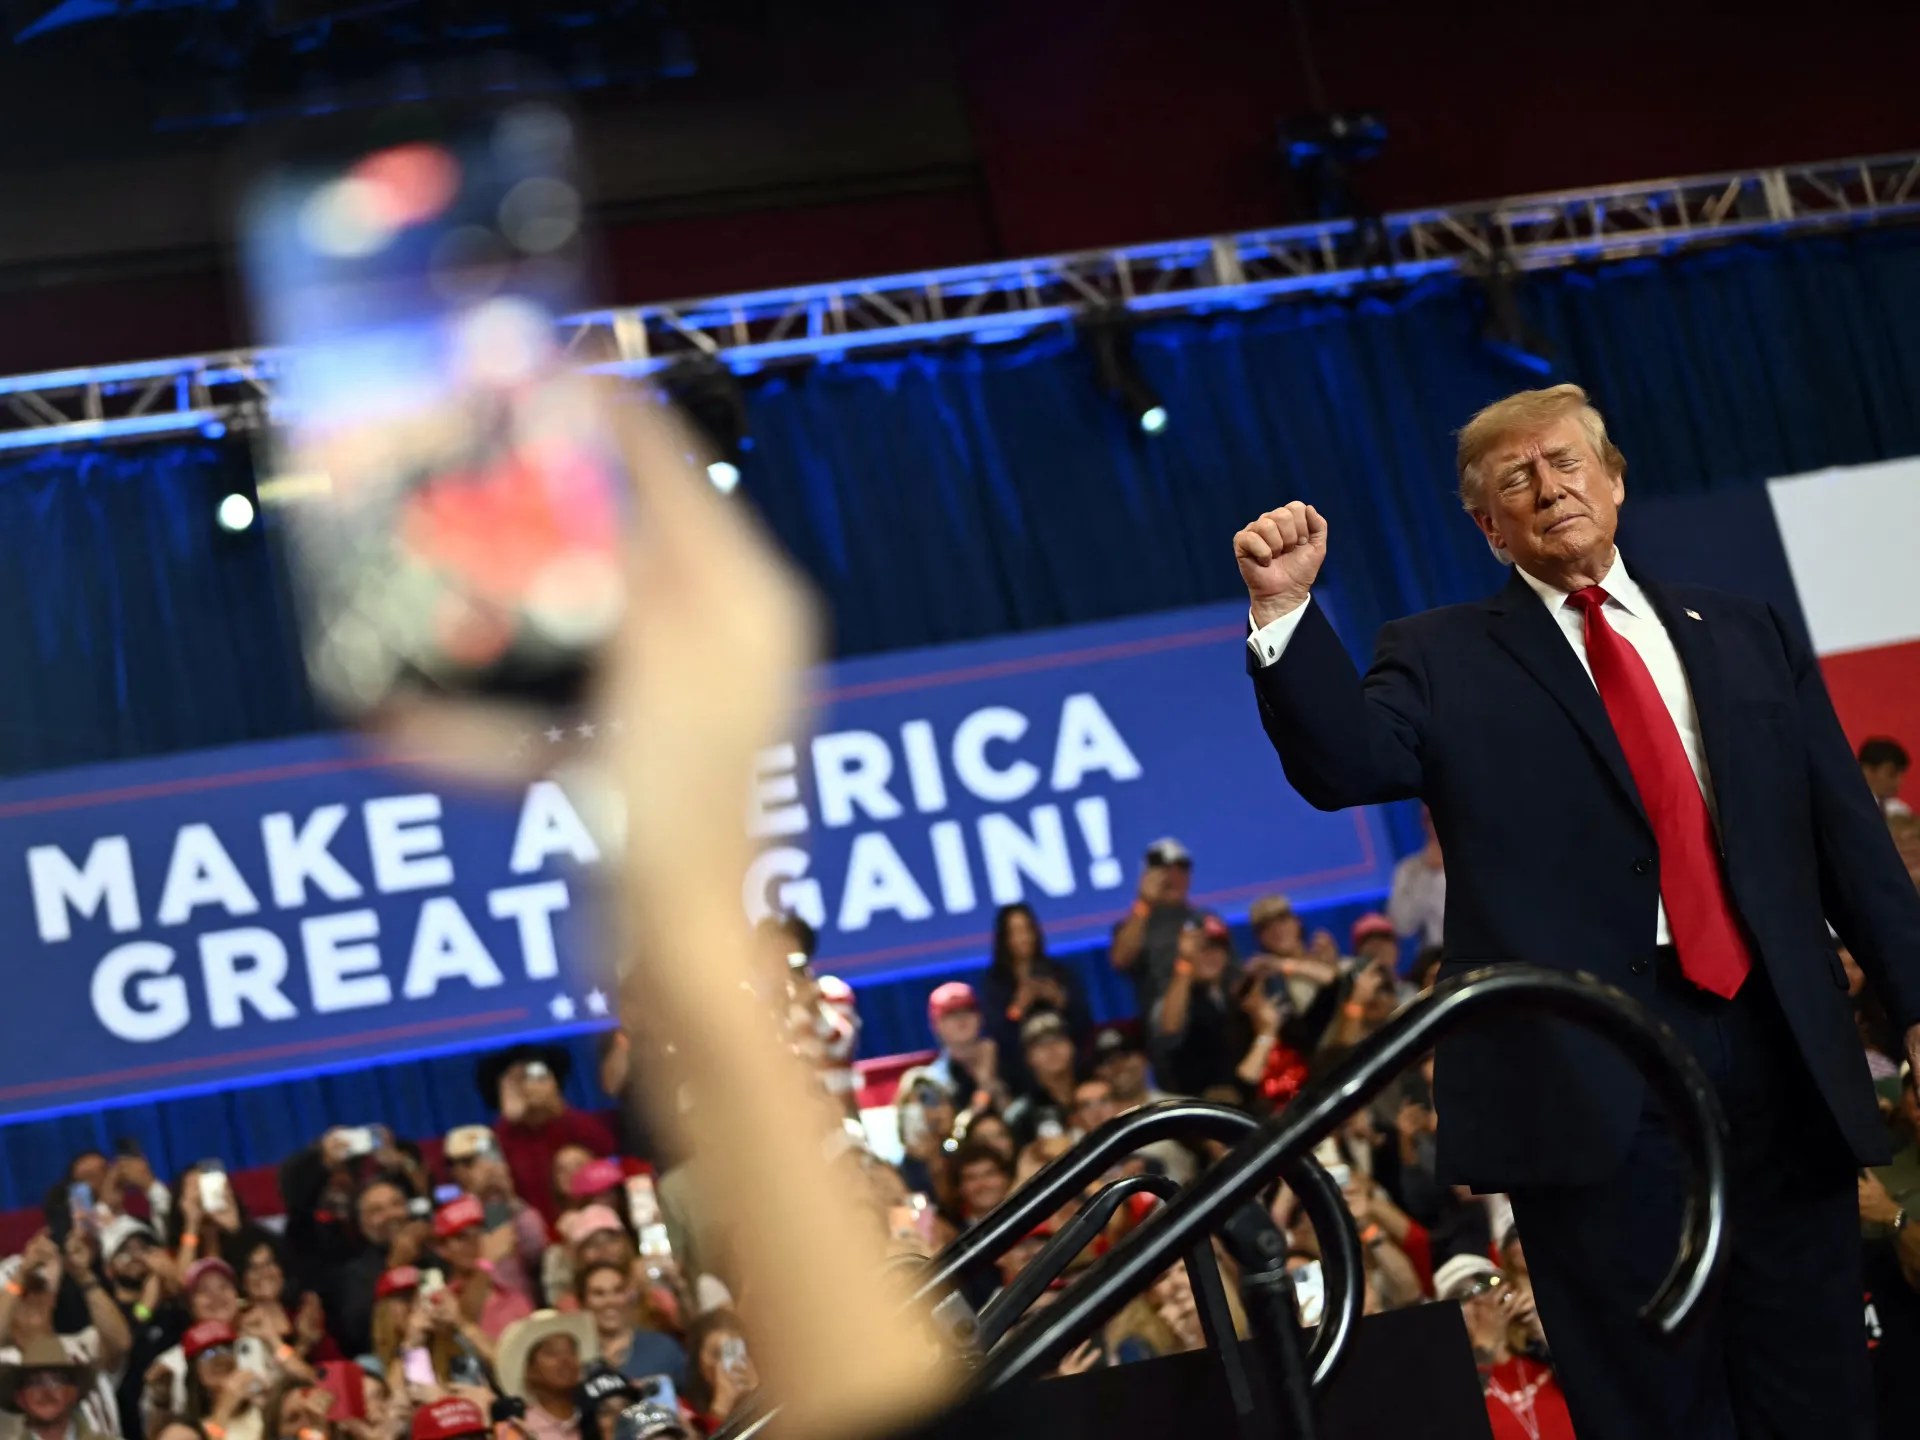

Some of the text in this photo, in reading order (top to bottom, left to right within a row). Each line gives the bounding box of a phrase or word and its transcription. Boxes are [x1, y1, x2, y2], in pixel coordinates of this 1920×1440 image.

[27, 692, 1141, 943] MAKE AERICA
[90, 796, 1122, 1042] GREAT GAIN!
